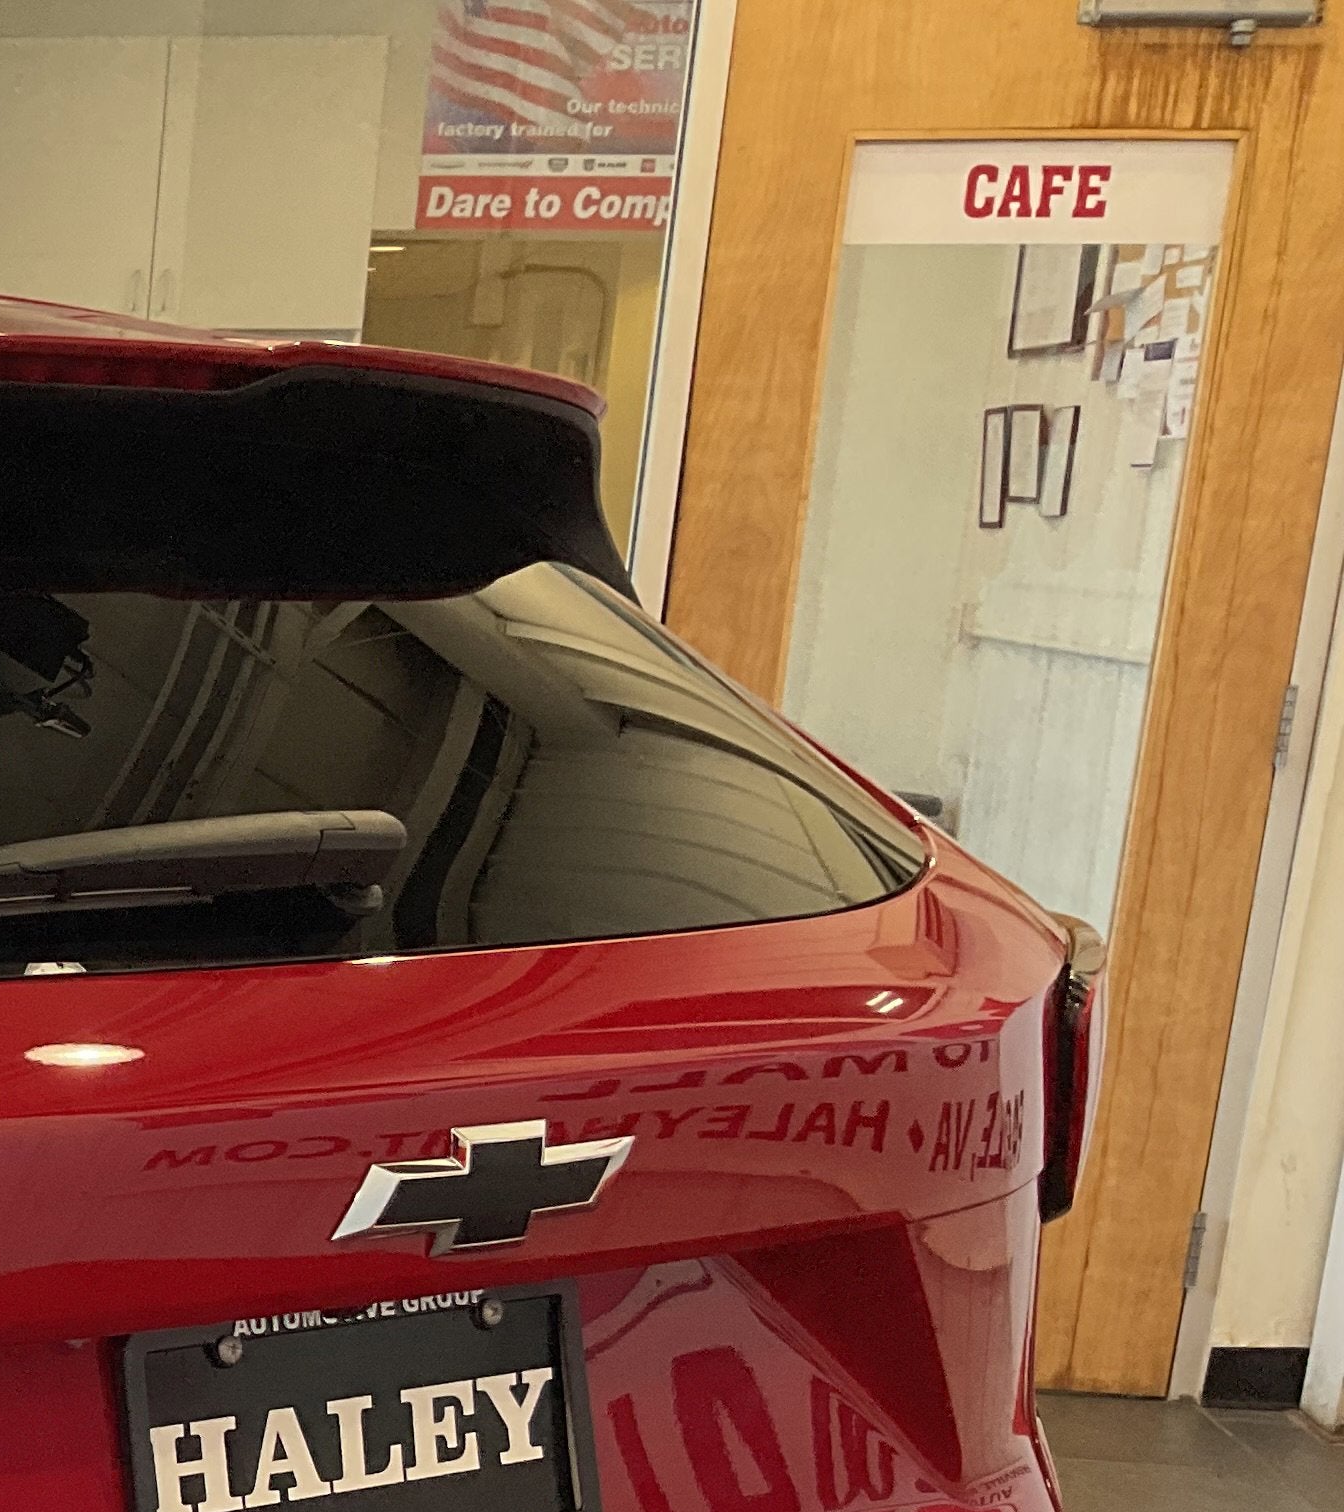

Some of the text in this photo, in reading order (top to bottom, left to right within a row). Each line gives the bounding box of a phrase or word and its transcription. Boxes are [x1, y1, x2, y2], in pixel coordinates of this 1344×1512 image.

[607, 44, 681, 71] SER
[567, 100, 602, 115] Our
[438, 122, 613, 142] factory trained for
[426, 186, 512, 219] Dare
[524, 187, 561, 218] to
[964, 164, 1111, 218] CAFE
